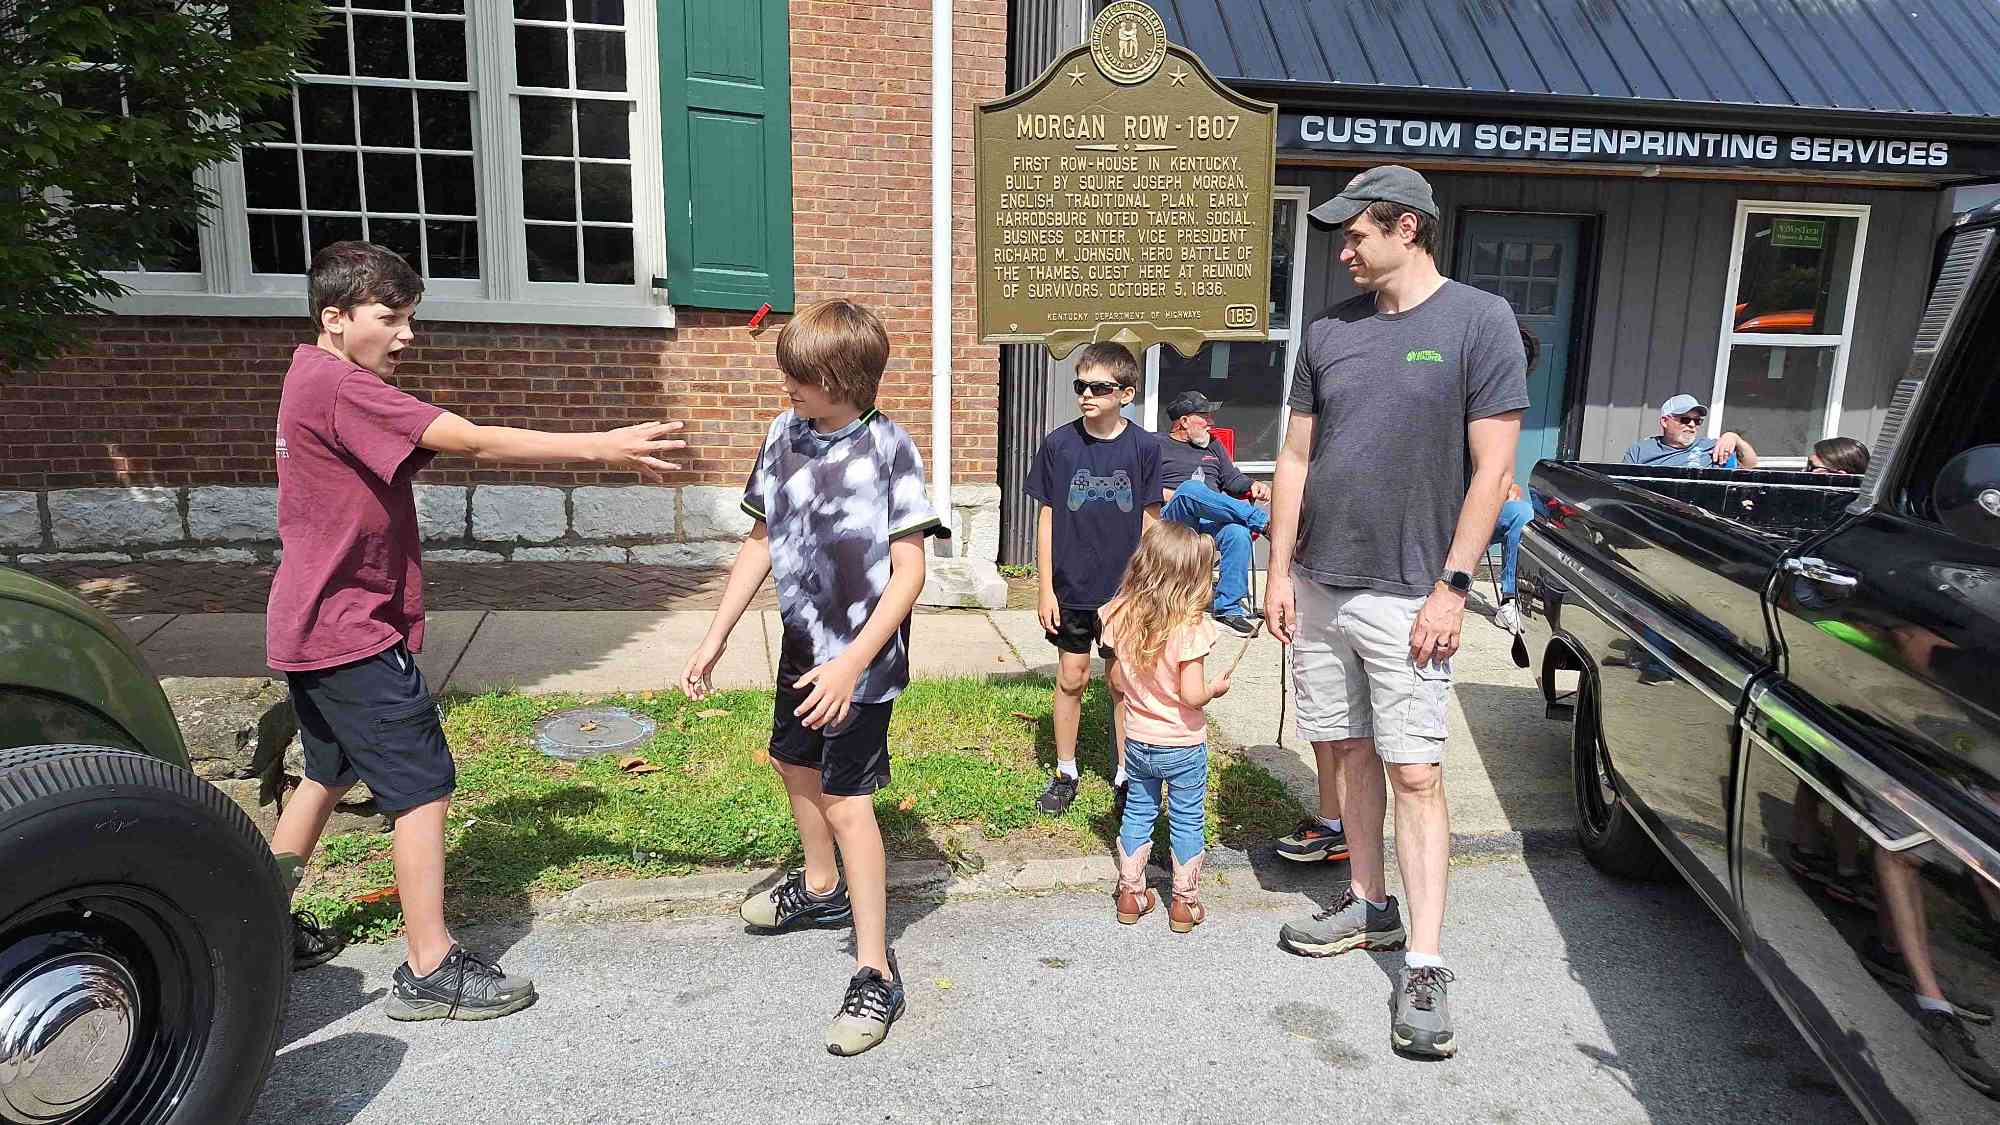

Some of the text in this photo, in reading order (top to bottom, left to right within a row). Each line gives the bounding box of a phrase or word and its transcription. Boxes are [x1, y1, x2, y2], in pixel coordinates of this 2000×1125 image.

[1016, 114, 1105, 139] MORGAN
[1124, 115, 1169, 139] ROW
[1188, 115, 1240, 139] 1807
[1300, 115, 1950, 166] CUSTOM SCREENPRINTING SERVICES
[1013, 156, 1242, 171] FIRST ROW-HOUSE IN KENTUCKY.
[1006, 174, 1248, 191] BUILT BY SQUIRE JOSEPH MORGAN.
[1000, 192, 1249, 208] ENGLISH TRADITIONAL PLAN. EARLY
[996, 211, 1087, 227] HARRODSBURG
[1096, 211, 1139, 226] NOTED
[1003, 228, 1247, 245] BUSINESS CENTER. VICE PRESIDENT
[994, 245, 1253, 263] RICHARD M. JOHNSON, HERO BATTLE OF
[994, 266, 1020, 281] THE
[1088, 265, 1130, 280] GUEST
[1139, 264, 1171, 279] HERE
[1178, 264, 1194, 279] AT
[1202, 263, 1252, 279] REUNION
[1003, 283, 1019, 298] OF
[1109, 282, 1166, 297] OCTOBER
[1191, 281, 1227, 297] 1836.
[1047, 310, 1201, 321] KENTUCKY DEPARTMENT OF HIGHWAYS
